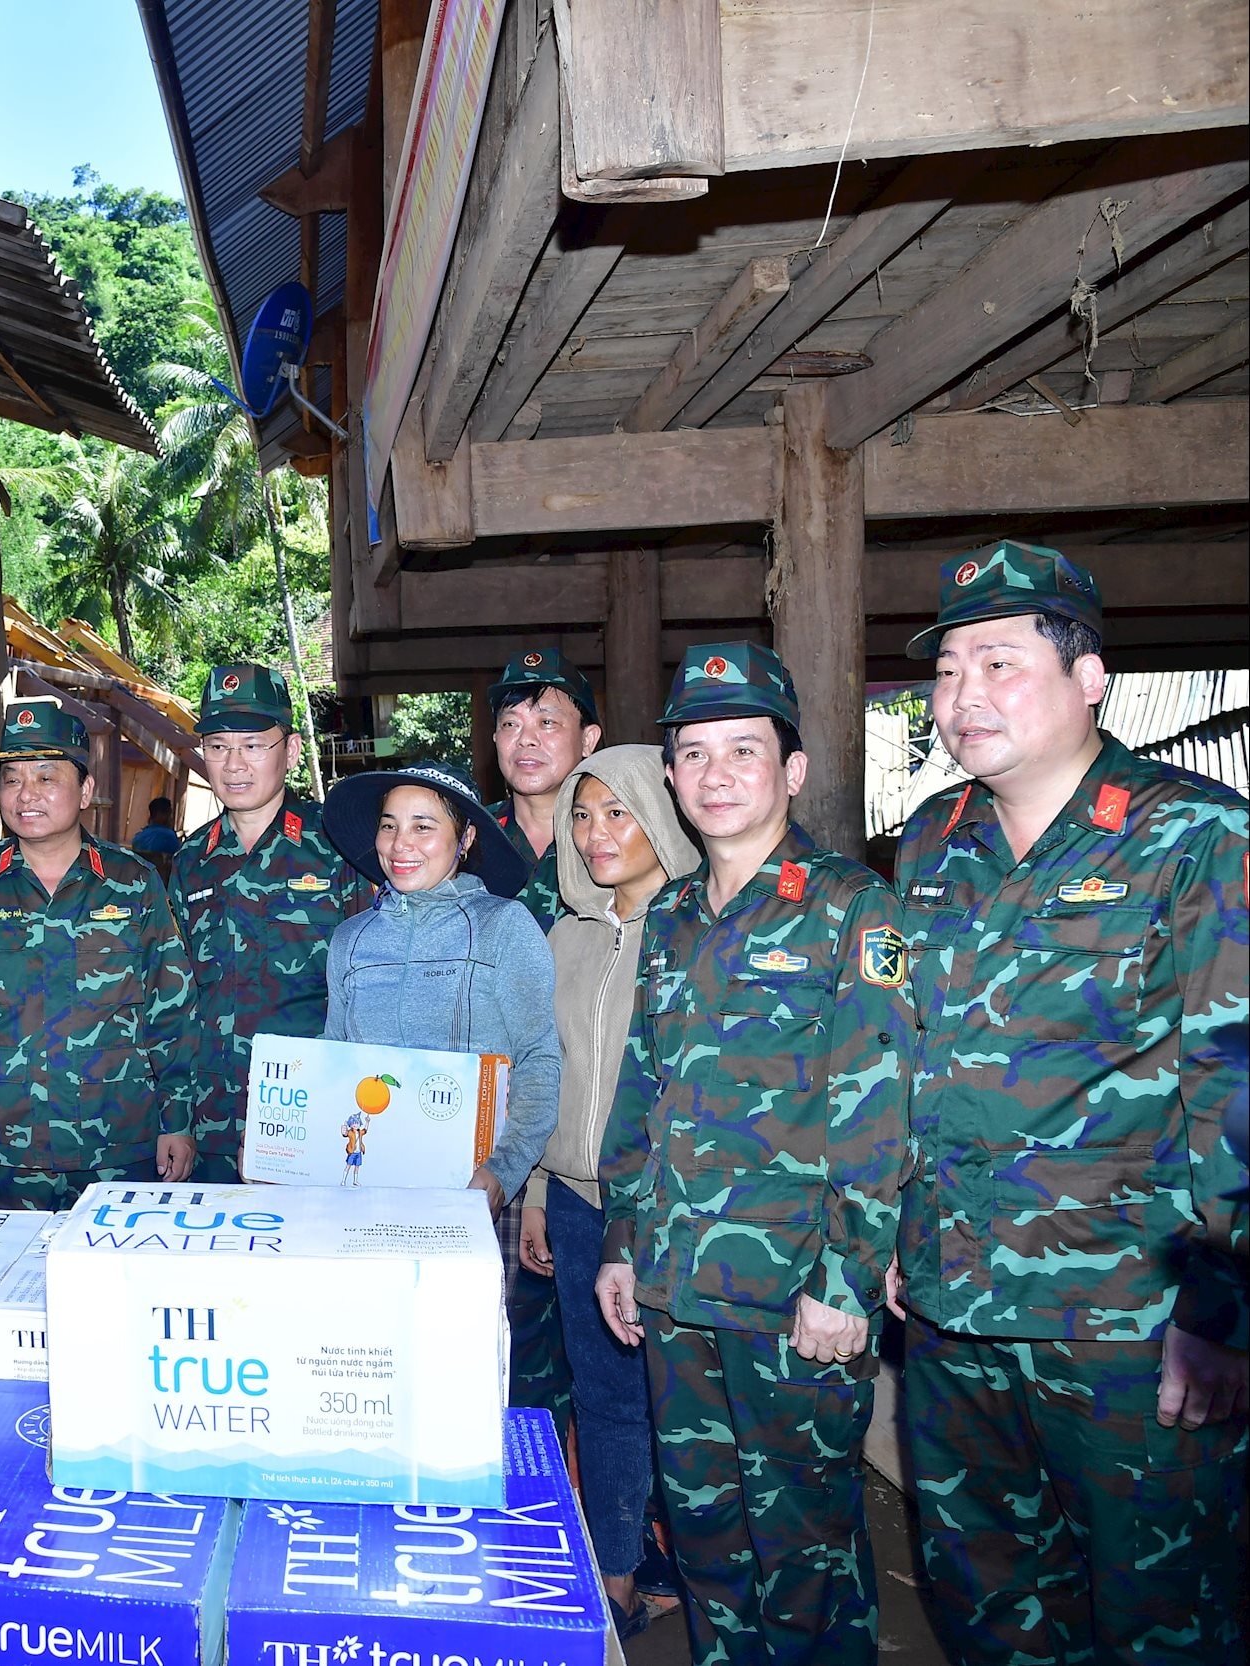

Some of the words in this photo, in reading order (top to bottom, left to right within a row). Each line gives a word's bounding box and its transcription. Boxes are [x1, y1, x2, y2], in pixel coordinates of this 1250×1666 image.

[13, 908, 22, 917] HÀ
[424, 968, 456, 978] ISOBLOX
[262, 1061, 290, 1080] TH
[425, 1076, 458, 1092] NATURE
[258, 1081, 308, 1108] true
[430, 1090, 451, 1104] TH
[258, 1106, 308, 1124] YOGURT
[258, 1122, 306, 1140] TOPKID
[108, 1190, 204, 1206] TH
[92, 1204, 284, 1231] true
[86, 1231, 282, 1252] WATER
[152, 1306, 219, 1341] TH
[12, 1330, 48, 1349] TH
[320, 1346, 344, 1356] Nước
[368, 1346, 392, 1356] khiết
[148, 1345, 268, 1396] true
[341, 1358, 362, 1366] nước
[312, 1368, 326, 1376] núi
[320, 1392, 357, 1414] 350
[364, 1394, 393, 1415] ml
[154, 1404, 270, 1434] WATER
[376, 1418, 394, 1427] chai
[303, 1427, 332, 1436] Bottled
[334, 1428, 368, 1440] drinking
[370, 1431, 394, 1439] water
[312, 1476, 322, 1484] 8.4
[344, 1478, 358, 1486] chai
[366, 1478, 379, 1486] 350
[283, 1524, 360, 1596] TH
[478, 1502, 585, 1613] MILK
